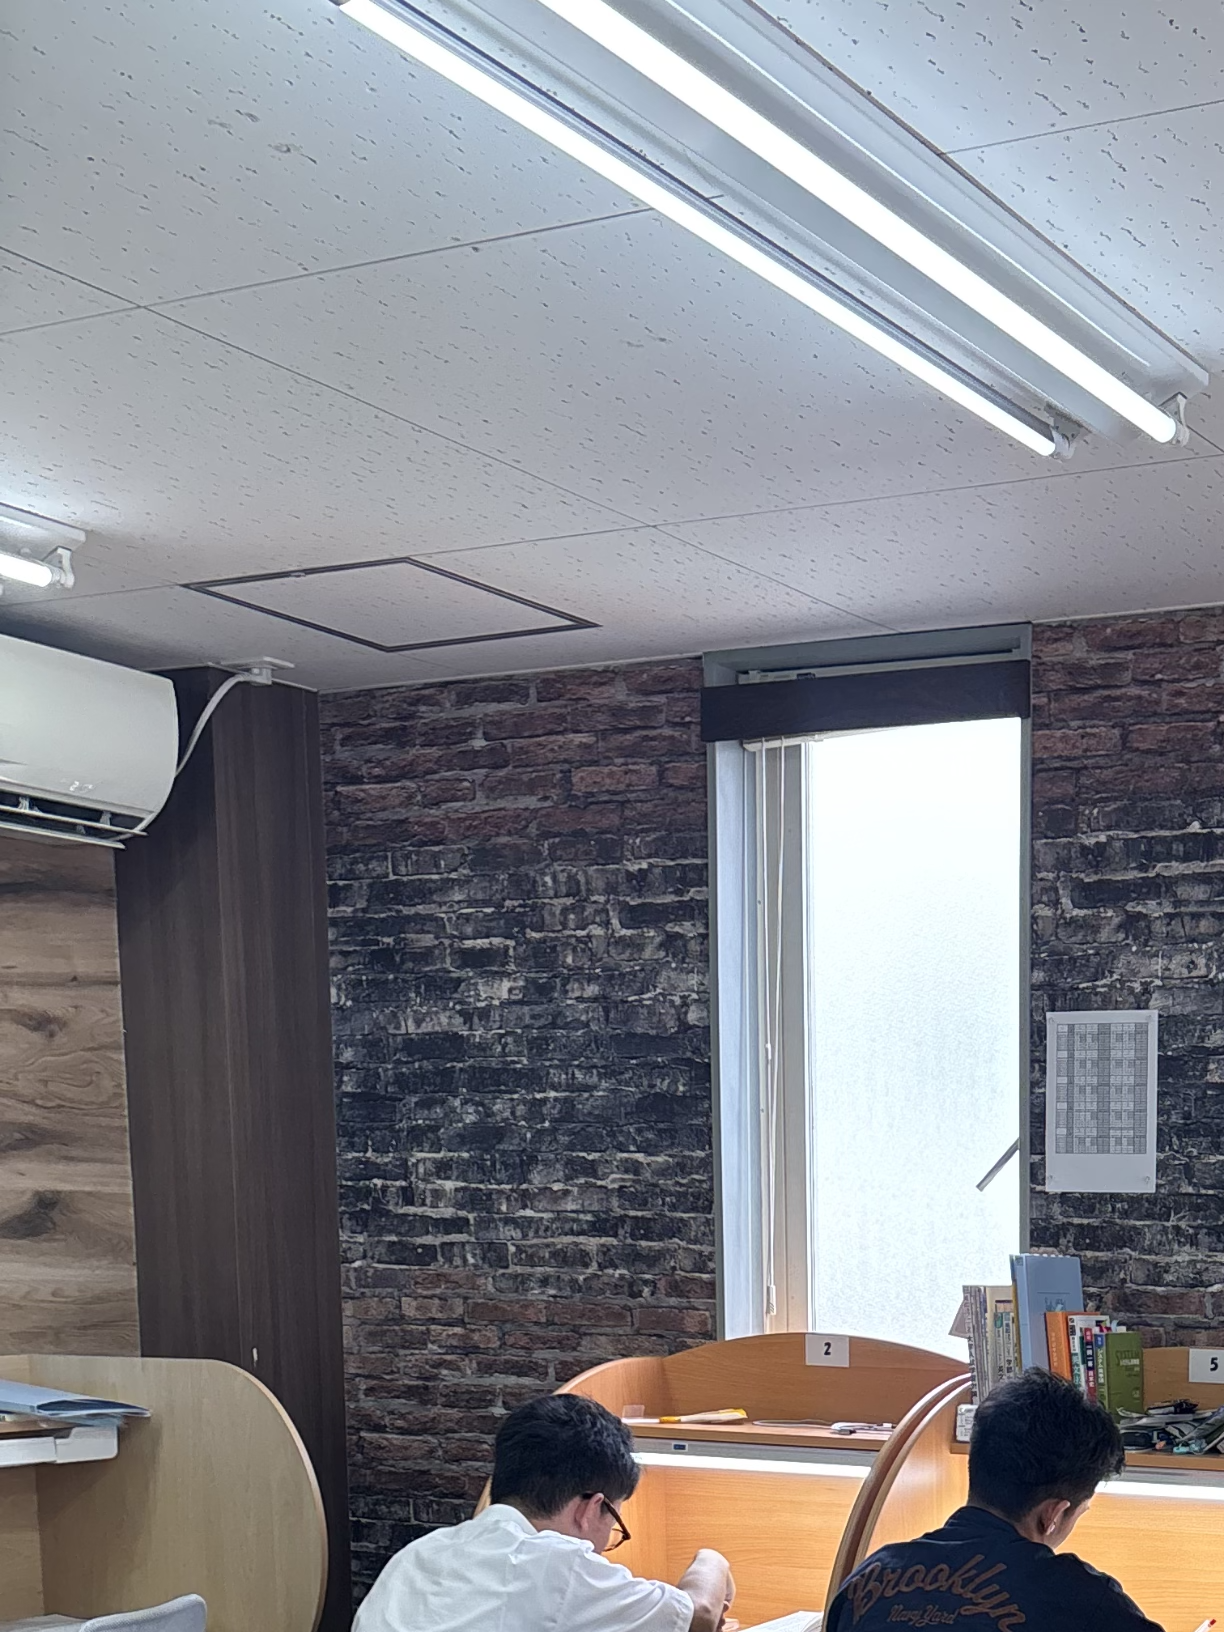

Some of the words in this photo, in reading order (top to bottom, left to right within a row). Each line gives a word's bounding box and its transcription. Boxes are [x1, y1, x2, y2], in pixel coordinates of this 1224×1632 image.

[824, 1342, 831, 1355] 2
[1210, 1357, 1218, 1371] 5
[888, 1605, 921, 1624] Navy
[916, 1604, 959, 1627] Yard
